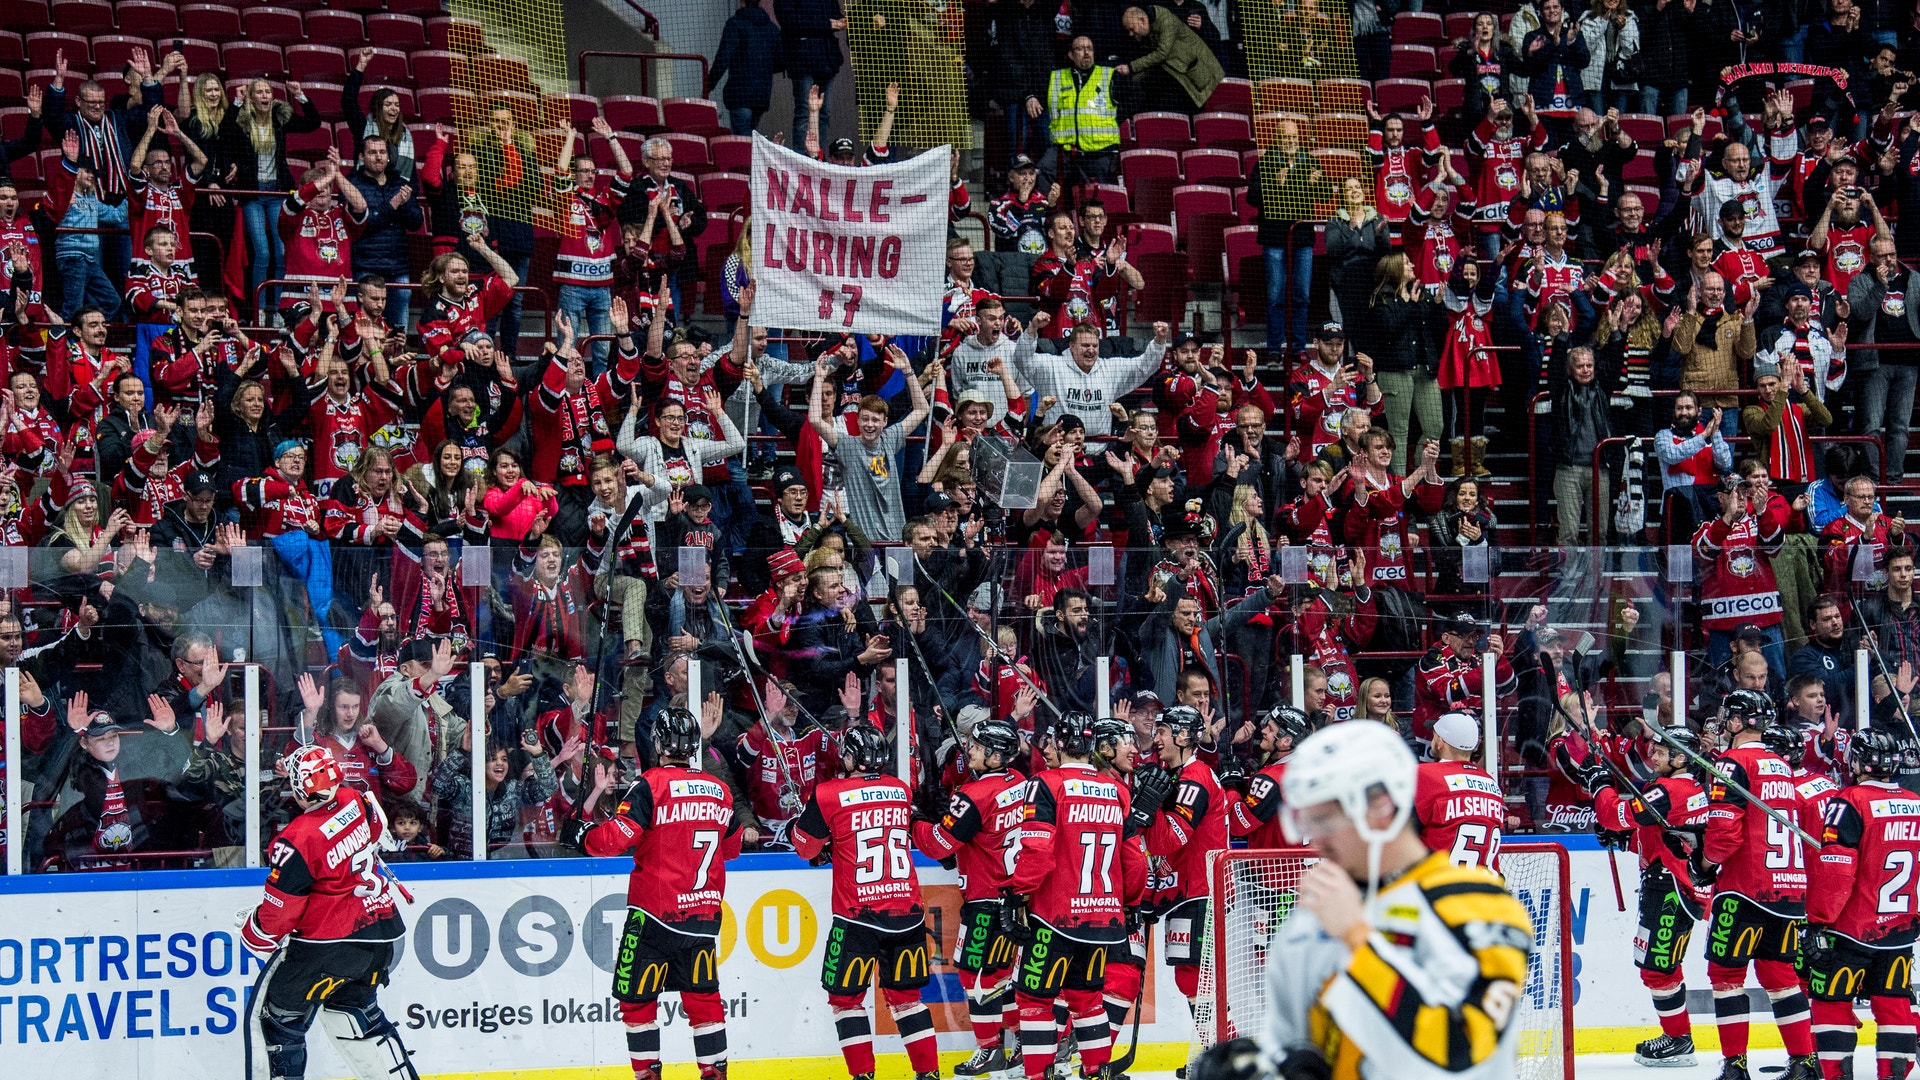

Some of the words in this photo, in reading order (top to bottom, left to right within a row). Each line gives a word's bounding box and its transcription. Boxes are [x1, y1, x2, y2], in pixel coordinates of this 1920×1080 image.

[766, 167, 927, 223] NALLE-
[764, 223, 902, 279] LURING
[818, 284, 863, 328] #7
[1713, 595, 1774, 615] areco
[1822, 655, 1835, 670] 6
[687, 781, 723, 799] bravida
[861, 788, 907, 801] bravida
[1176, 784, 1200, 807] 10
[1250, 777, 1274, 799] 59
[851, 807, 908, 831] EKBERG
[271, 842, 295, 867] 37
[691, 830, 720, 891] 7
[855, 827, 911, 884] 56
[1079, 831, 1118, 894] 11
[965, 911, 991, 970] akea
[1709, 897, 1739, 958] akea
[616, 932, 640, 995] akea
[823, 926, 845, 987] akea
[1024, 927, 1054, 991] akea
[406, 1000, 533, 1034] Sveriges
